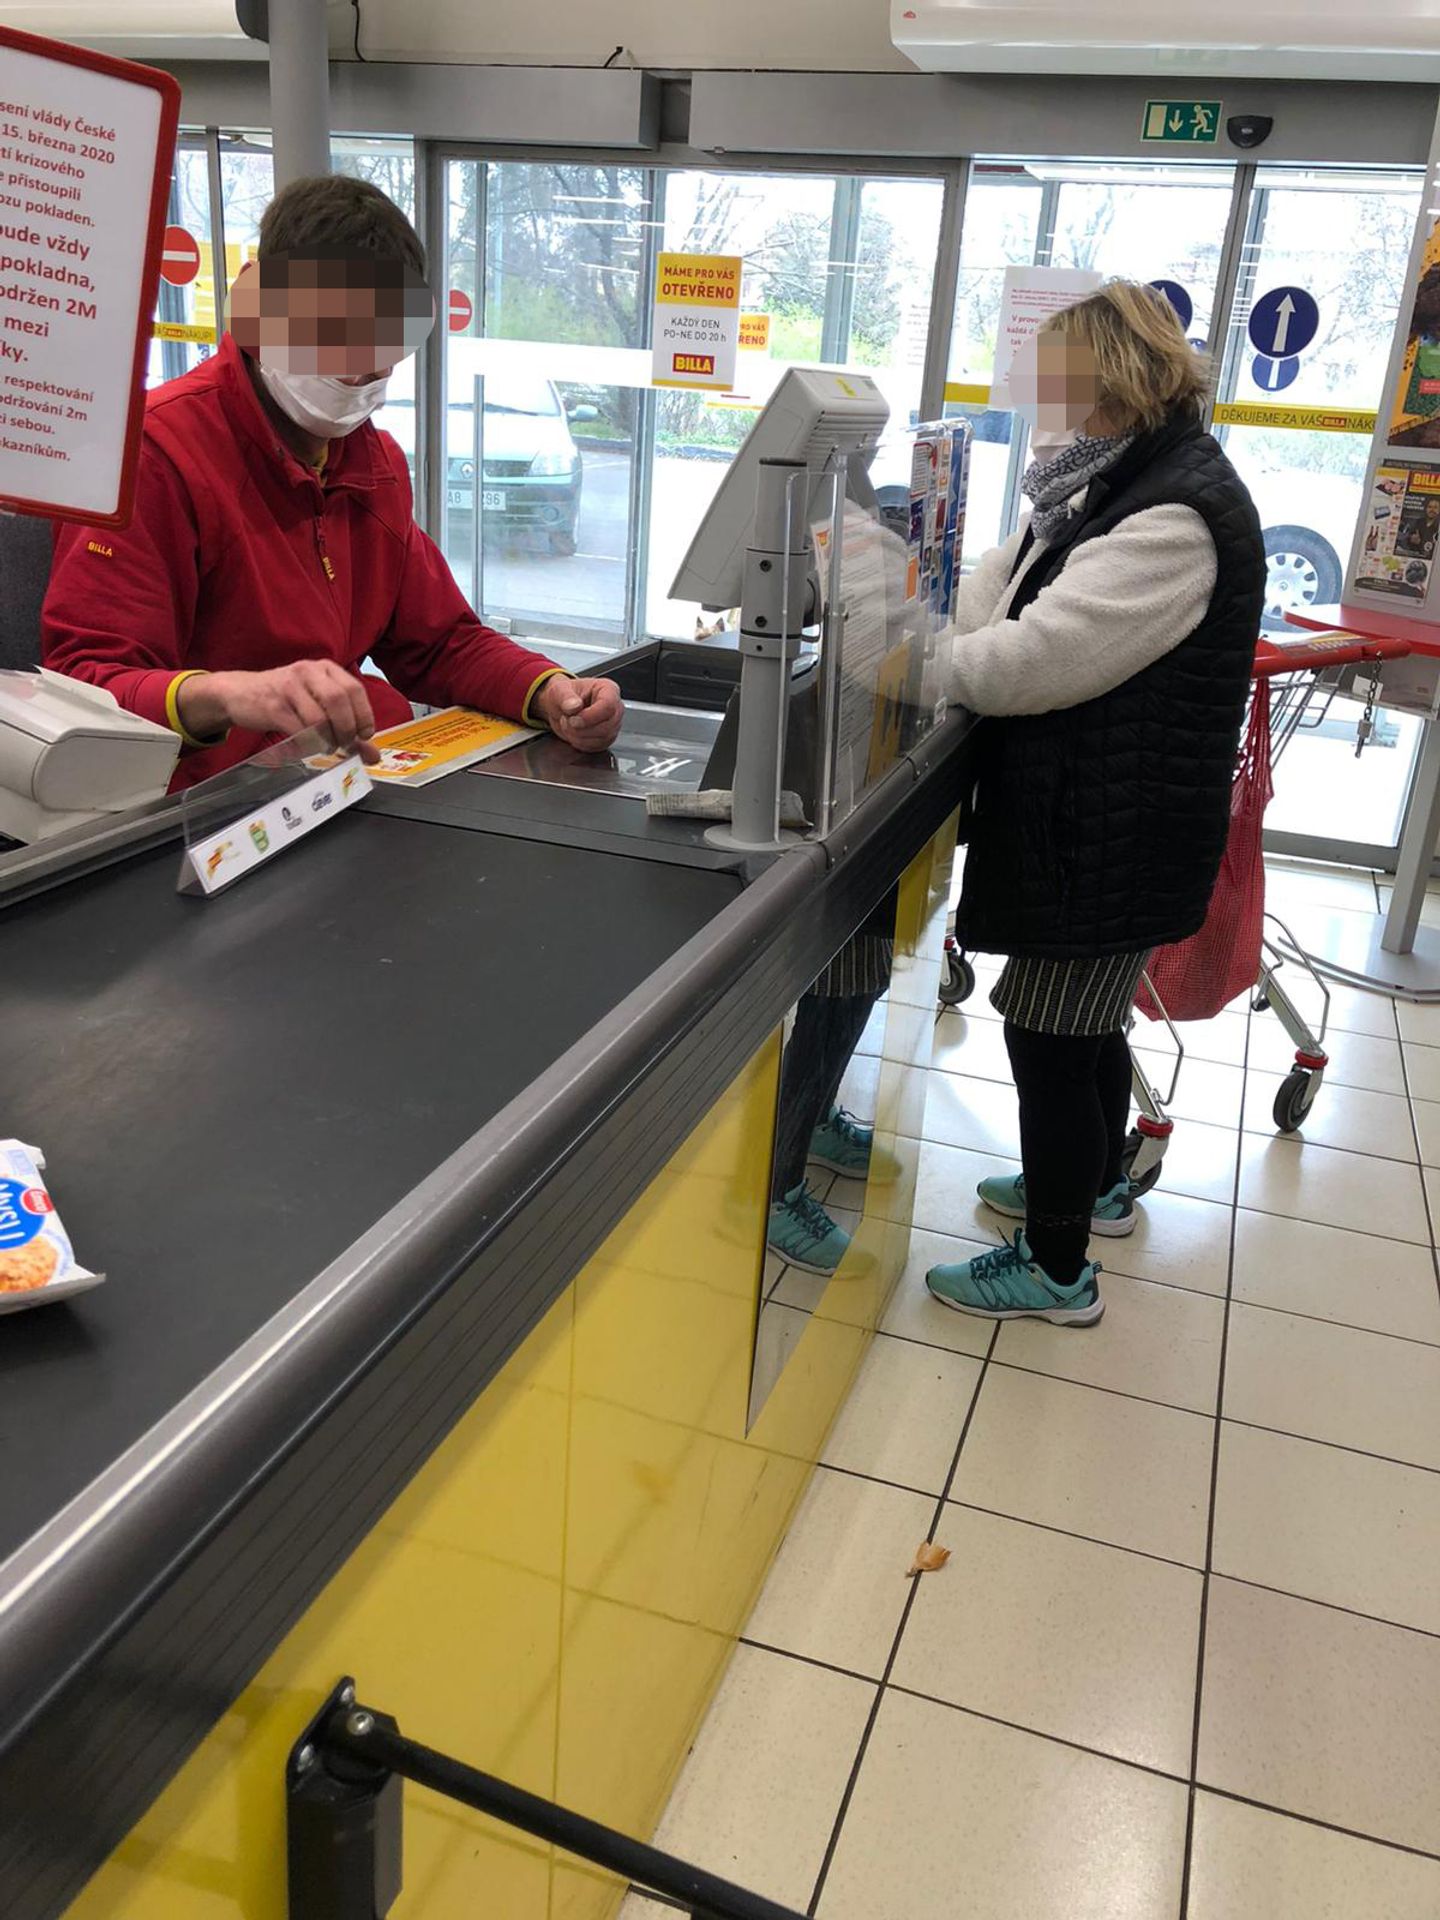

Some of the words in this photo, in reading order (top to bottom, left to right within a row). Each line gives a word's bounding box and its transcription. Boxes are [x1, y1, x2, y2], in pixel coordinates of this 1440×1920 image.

[32, 109, 71, 131] vlády
[74, 117, 116, 141] České
[2, 123, 23, 140] 15.
[28, 129, 76, 153] března
[80, 144, 115, 164] 2020
[15, 150, 85, 179] krizového
[8, 173, 81, 201] přistoupili
[25, 201, 95, 227] pokladen.
[46, 235, 90, 261] vždy
[0, 255, 95, 292] pokladna,
[664, 266, 692, 278] MÁME
[695, 269, 714, 279] PRO
[662, 281, 734, 299] OTEVŘENO
[66, 298, 97, 320] 2M
[4, 316, 49, 337] mezi
[671, 316, 699, 328] KAŽDÝ
[702, 319, 720, 329] DEN
[663, 329, 692, 339] PO-NE
[695, 332, 706, 341] DO
[709, 332, 719, 342] 20
[675, 357, 712, 372] BILLA
[4, 375, 95, 402] respektování
[66, 407, 88, 421] 2m
[1221, 408, 1279, 424] DĚKUJEME
[1282, 413, 1296, 425] ZA
[1300, 413, 1323, 426] VÁŠ
[10, 418, 55, 435] sebou.
[0, 437, 71, 462] kazníkům.
[87, 541, 113, 558] BILLA
